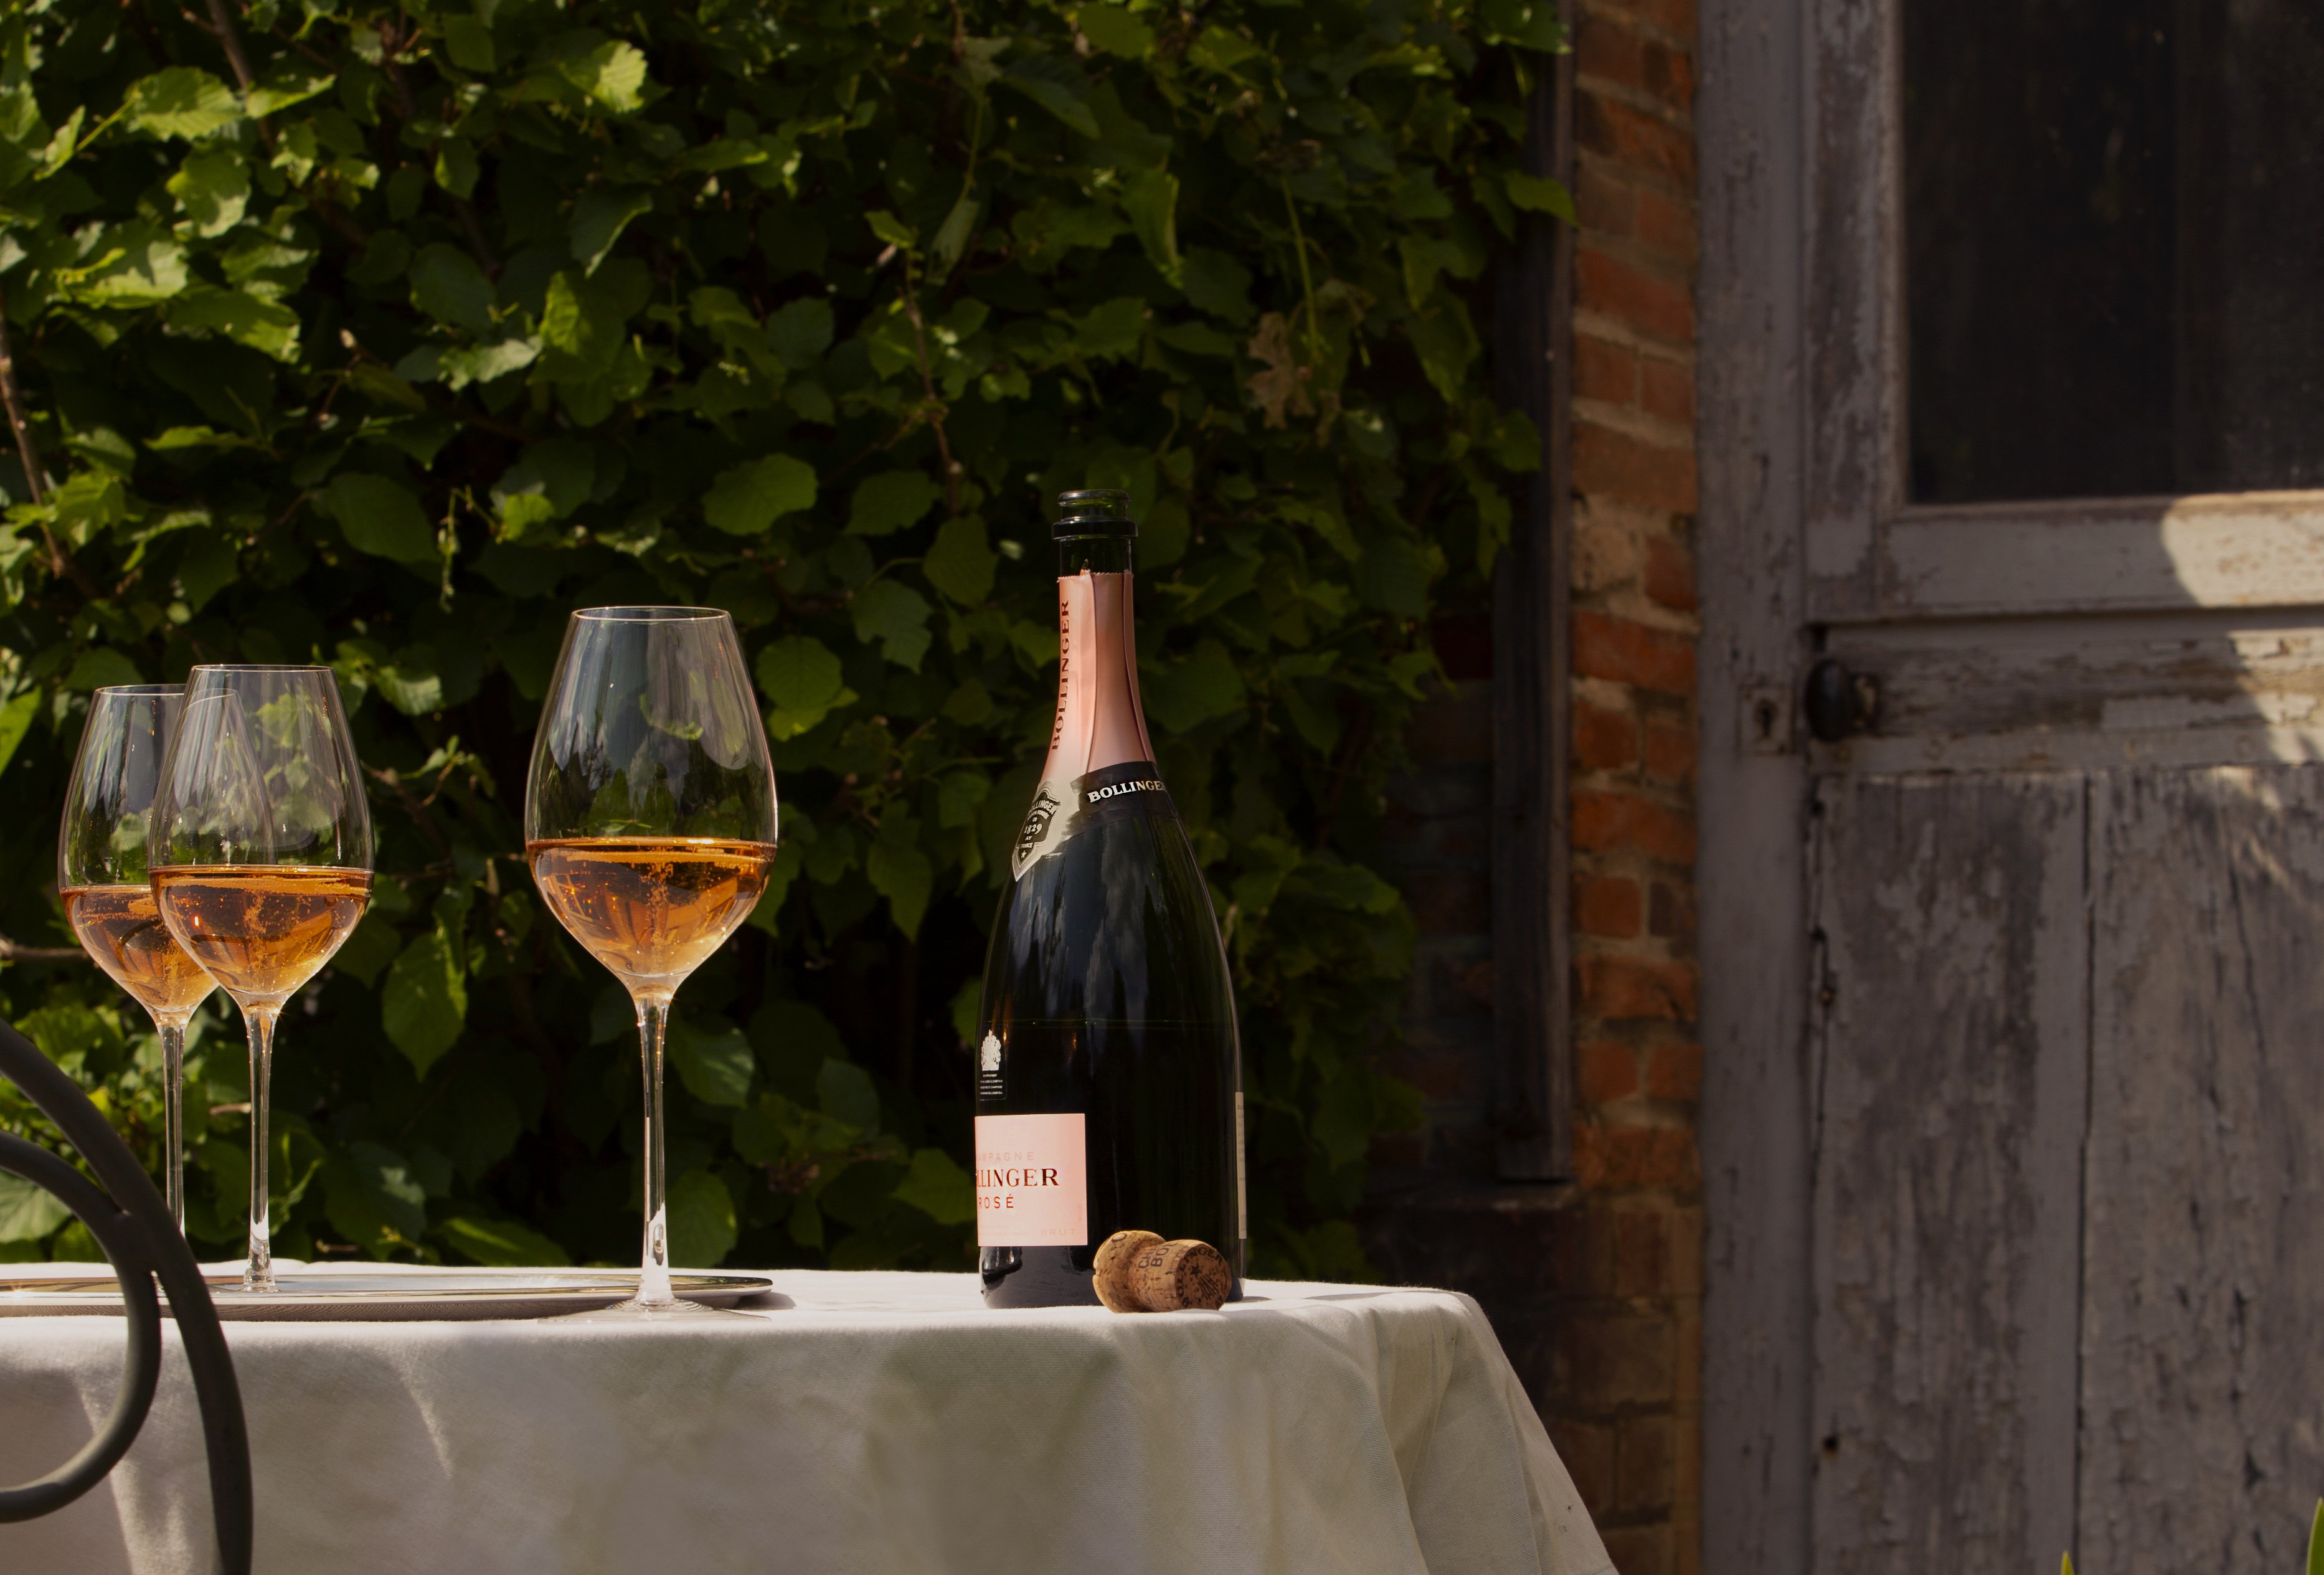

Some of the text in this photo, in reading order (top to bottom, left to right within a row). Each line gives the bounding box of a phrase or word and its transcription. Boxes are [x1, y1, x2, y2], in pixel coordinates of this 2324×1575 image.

[1051, 598, 1070, 751] BOLLINGER
[1087, 780, 1166, 803] BOLLINGE
[1023, 823, 1042, 835] 1829
[978, 1194, 1014, 1209] ROSÉ
